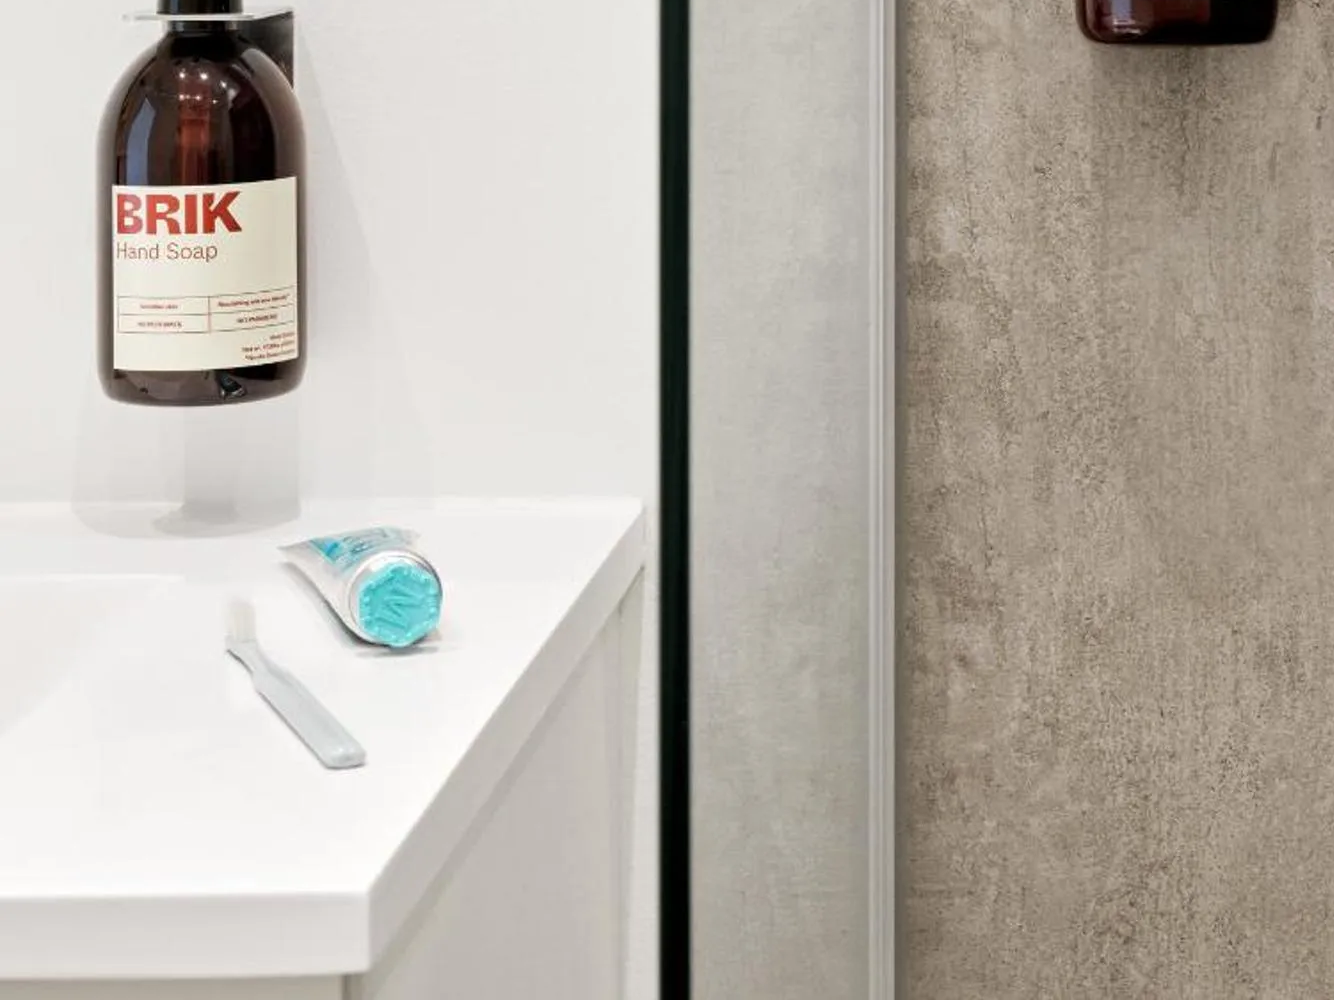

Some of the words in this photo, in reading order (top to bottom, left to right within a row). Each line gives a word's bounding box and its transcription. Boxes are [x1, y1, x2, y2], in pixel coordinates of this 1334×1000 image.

[117, 191, 242, 234] BRIK
[116, 242, 159, 260] Hand
[167, 242, 218, 262] Soap
